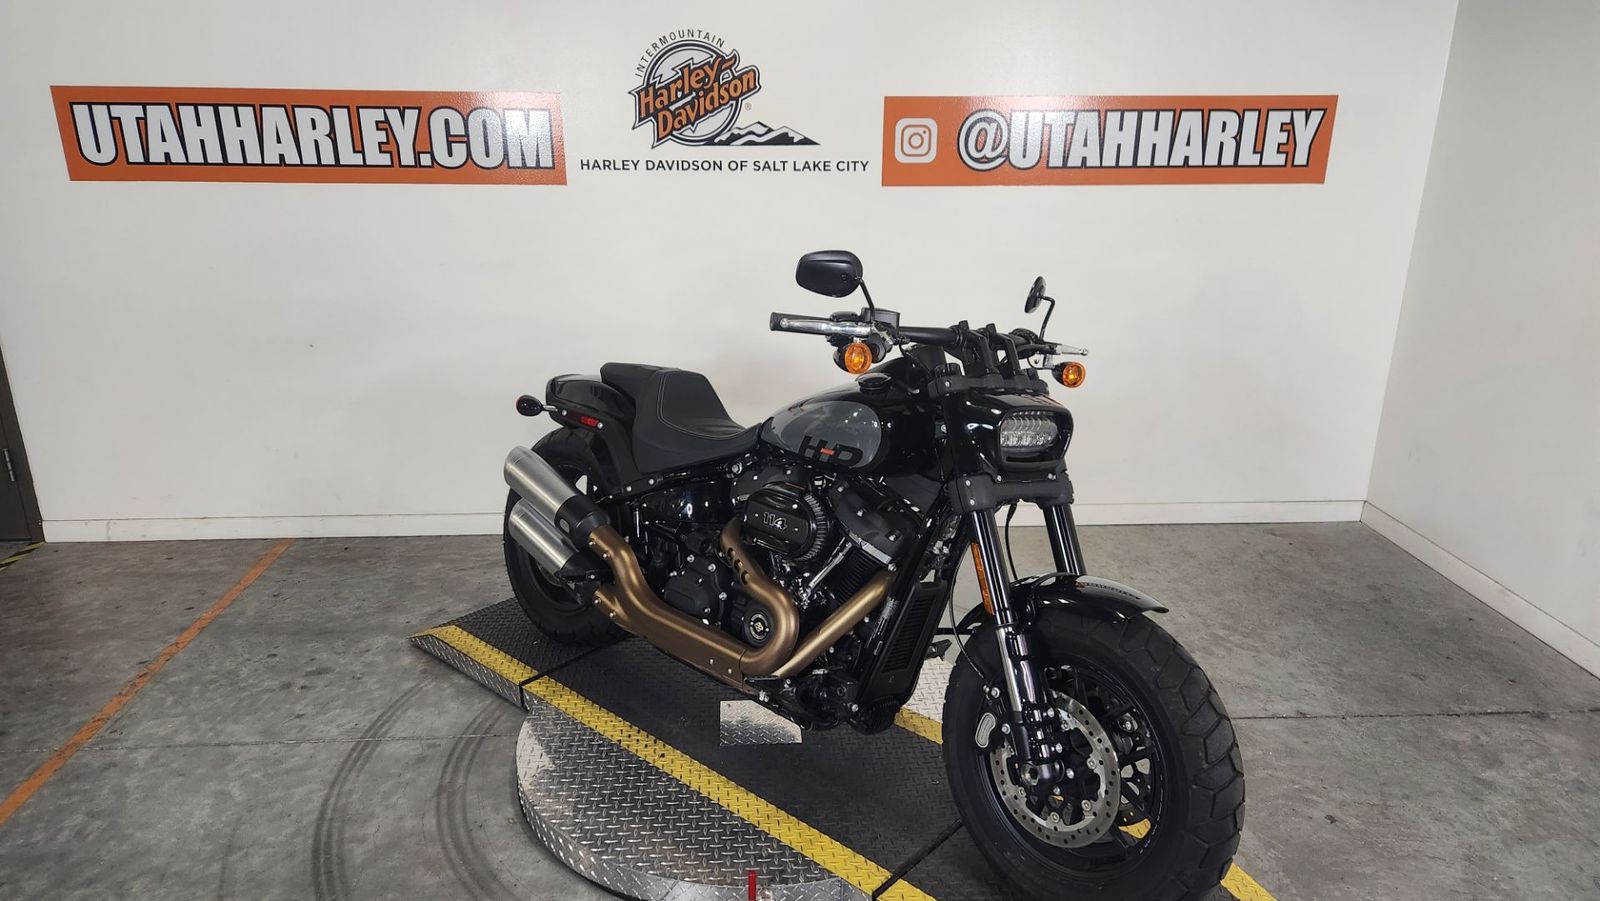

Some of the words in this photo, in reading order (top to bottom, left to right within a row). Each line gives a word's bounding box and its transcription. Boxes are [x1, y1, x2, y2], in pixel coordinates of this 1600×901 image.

[635, 28, 725, 77] INTERMOUNTAIN
[656, 69, 756, 140] Davidson
[70, 101, 556, 169] UTAHHARLEY.COM
[957, 108, 1327, 171] @UTAHHARLEY
[580, 159, 640, 171] HARLEY
[645, 159, 722, 171] DAVIDSON
[728, 159, 748, 171] OF
[752, 160, 787, 172] SALT
[793, 160, 831, 172] LAKE
[836, 160, 869, 172] CITY
[763, 511, 787, 530] 114
